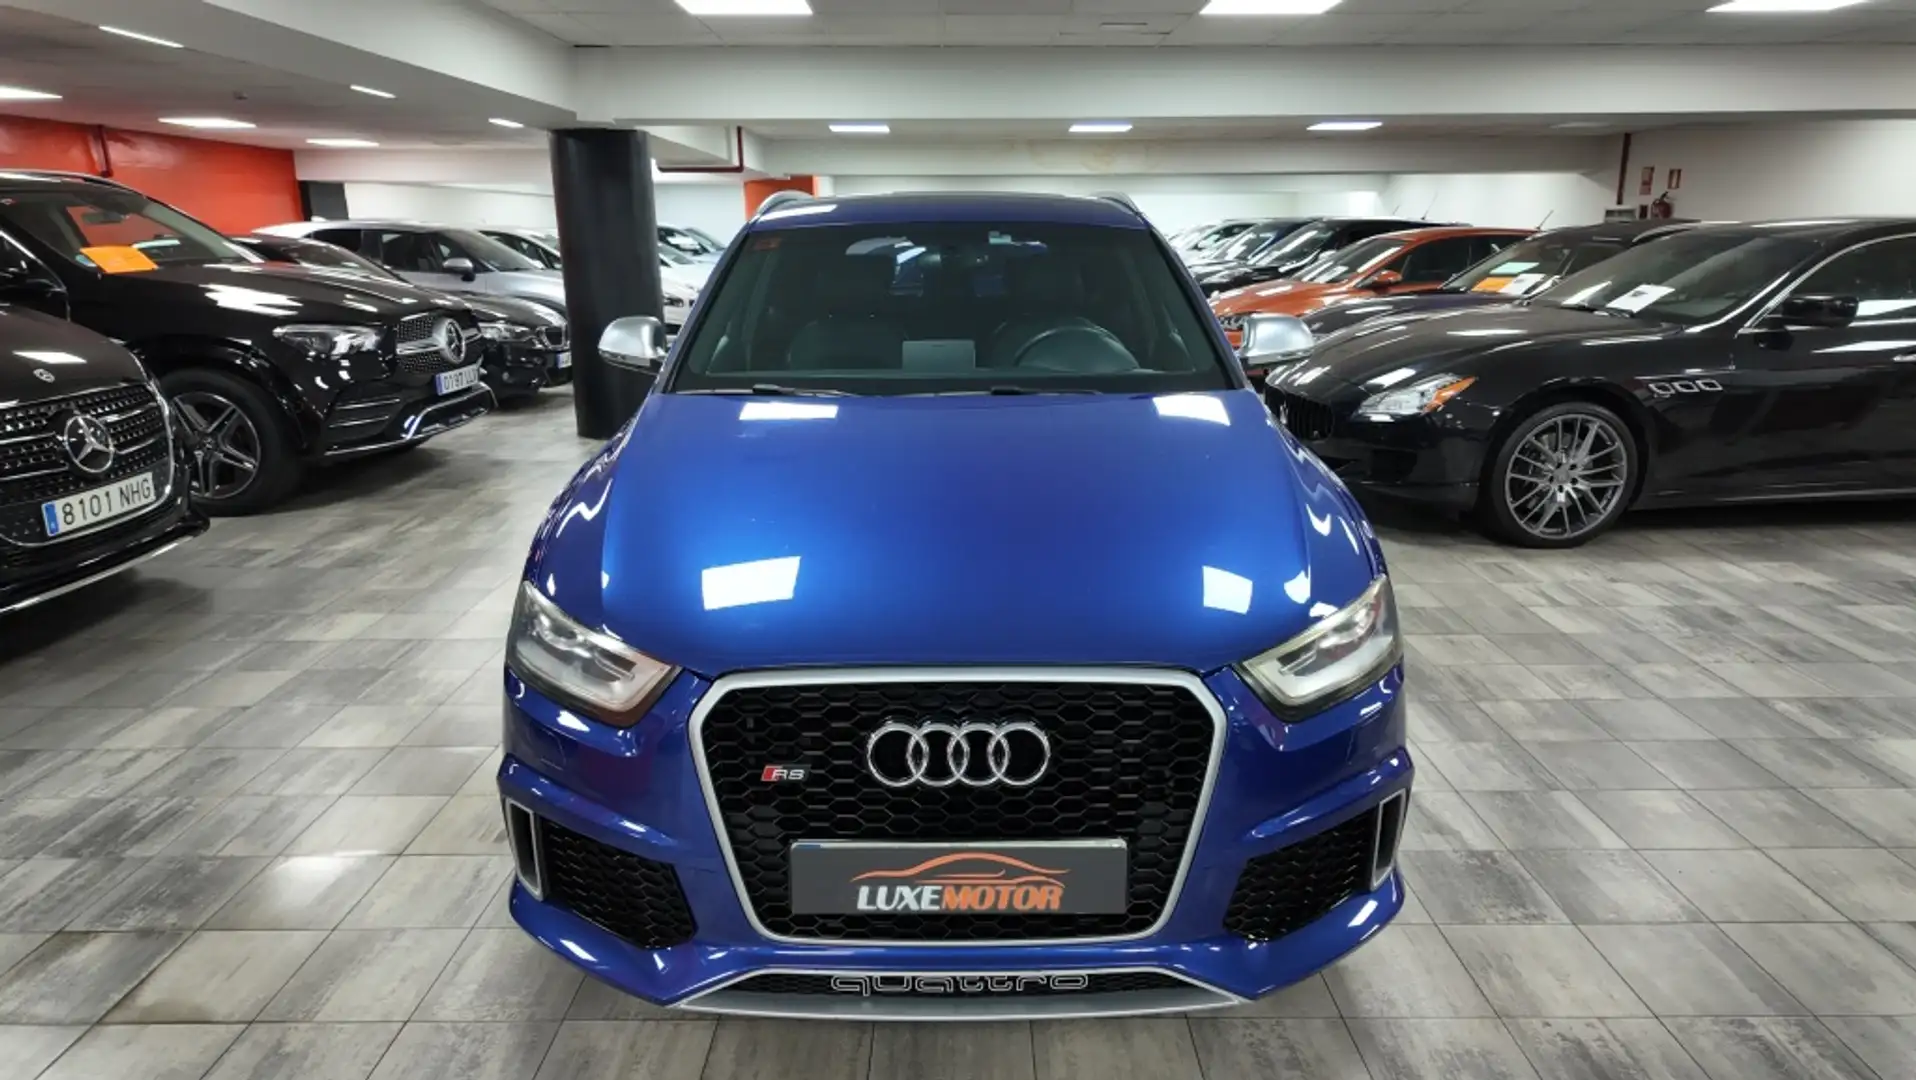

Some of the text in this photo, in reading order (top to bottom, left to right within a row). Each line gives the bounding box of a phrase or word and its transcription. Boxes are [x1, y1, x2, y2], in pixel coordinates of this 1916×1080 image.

[62, 479, 151, 525] 8101 NHG
[772, 769, 805, 780] RS
[857, 885, 1063, 911] LUXEMOTOR
[831, 974, 1088, 996] quattro
